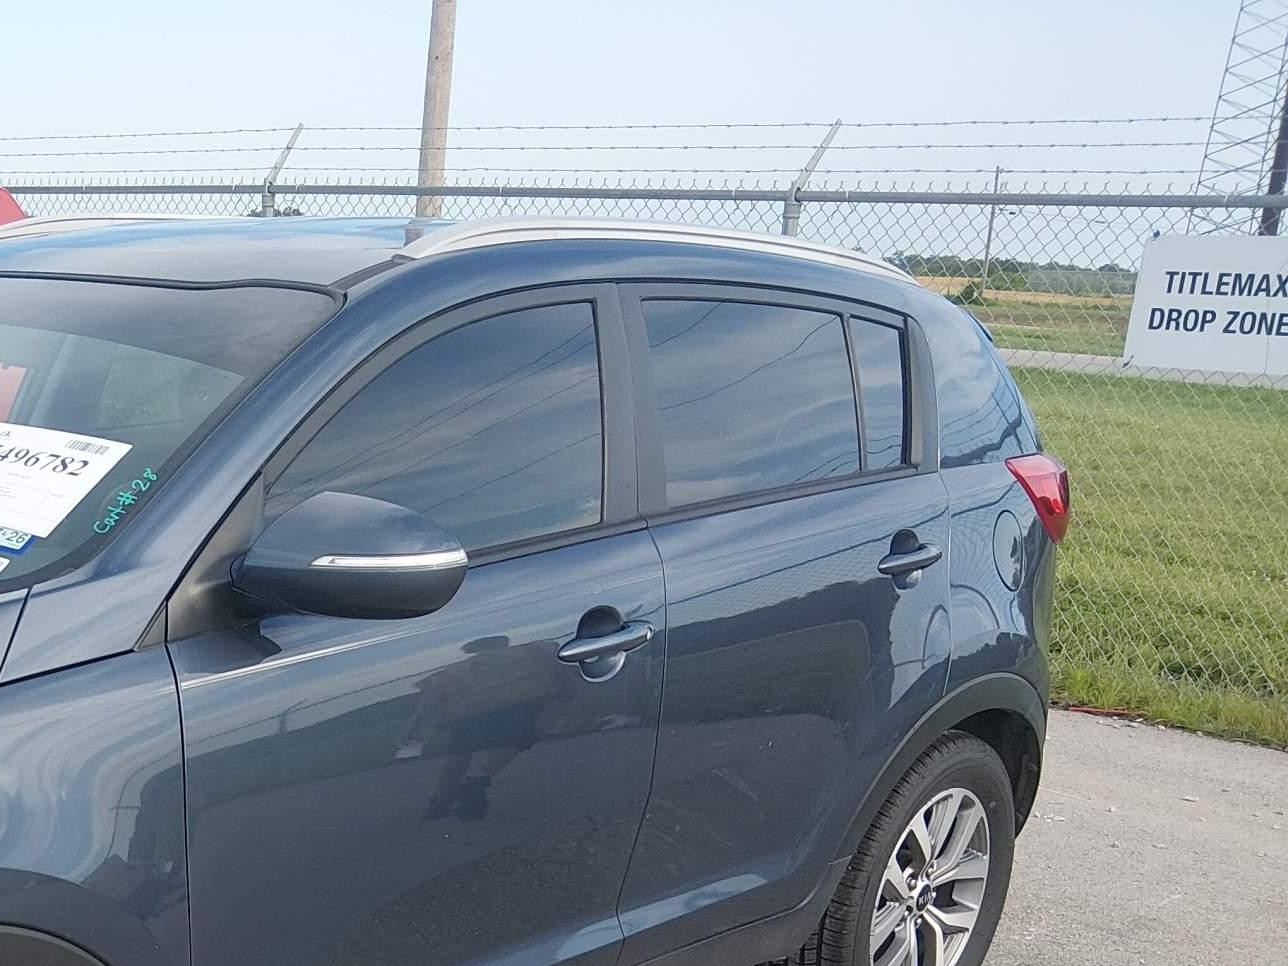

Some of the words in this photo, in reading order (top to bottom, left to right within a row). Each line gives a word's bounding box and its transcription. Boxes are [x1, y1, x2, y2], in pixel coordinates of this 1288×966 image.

[1165, 271, 1288, 298] TITLEMAX
[1148, 307, 1217, 333] DROP
[1222, 310, 1288, 337] ZONE
[6, 531, 29, 544] 26
[918, 891, 933, 906] KIA
